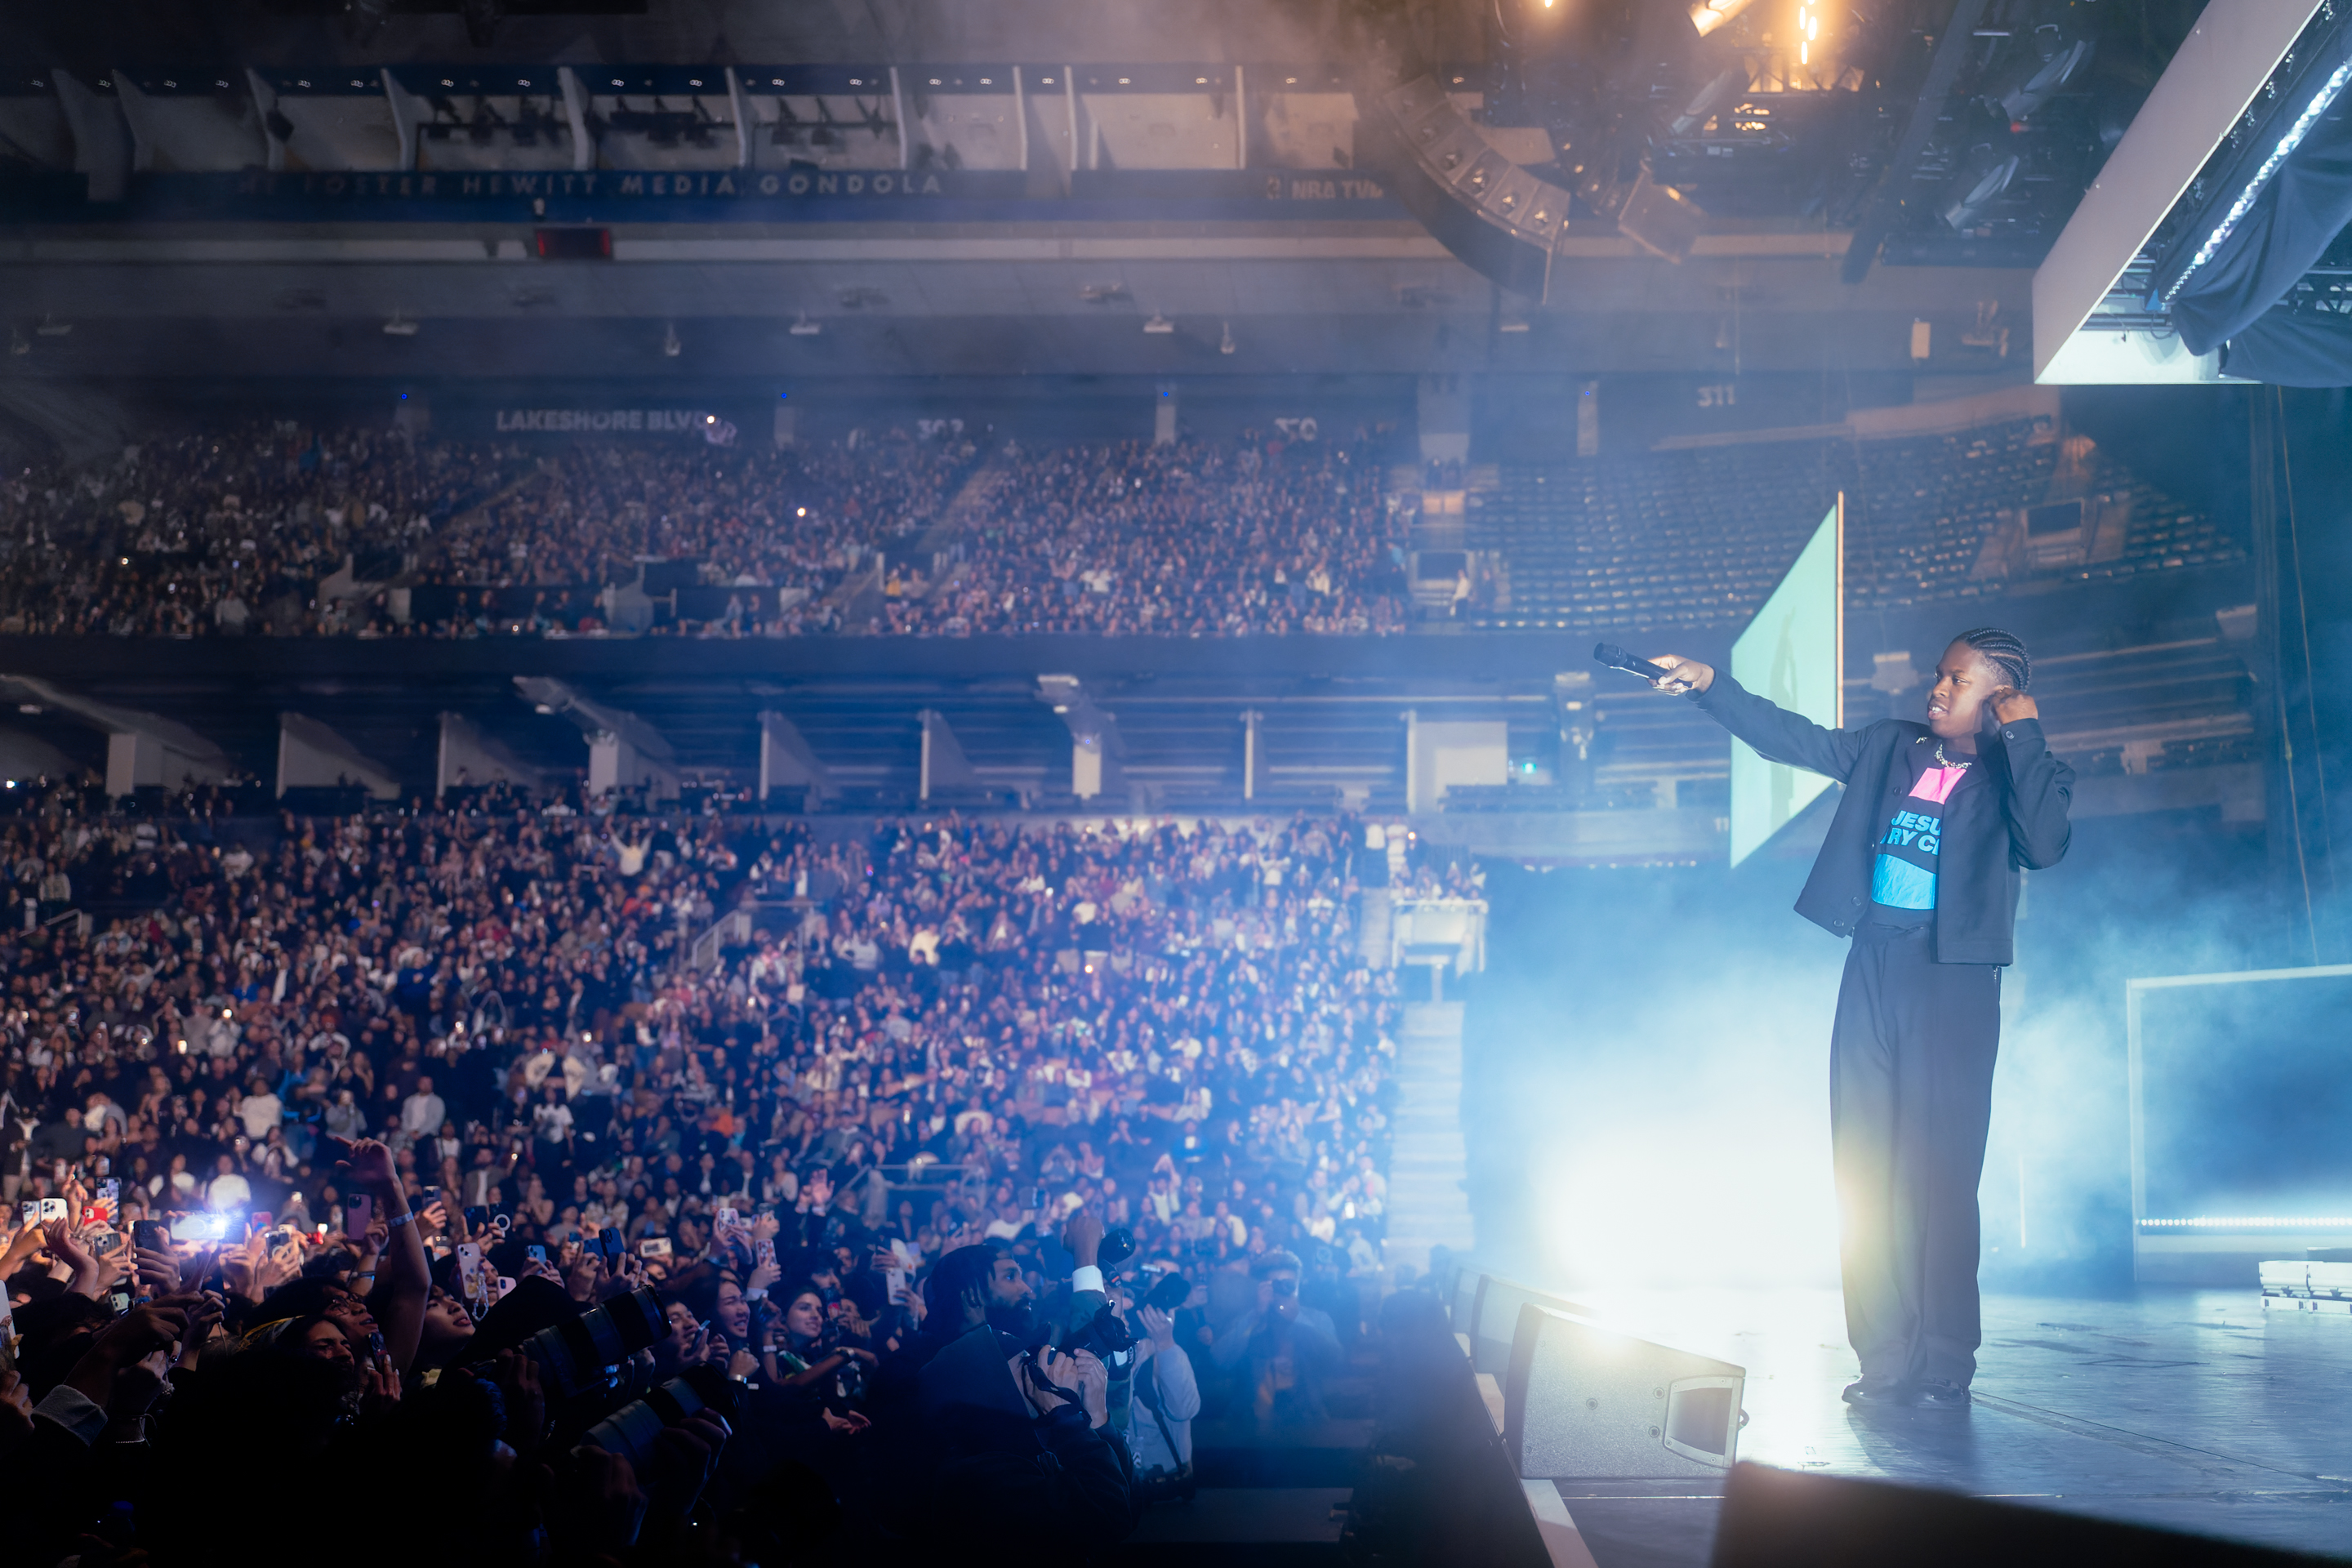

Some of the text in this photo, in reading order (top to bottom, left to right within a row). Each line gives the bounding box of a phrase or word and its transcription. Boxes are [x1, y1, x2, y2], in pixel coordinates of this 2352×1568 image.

[463, 175, 596, 195] HEWITT
[619, 175, 736, 195] MEDIA
[759, 175, 942, 195] GONDOLA
[496, 409, 642, 431] LAKESHORE
